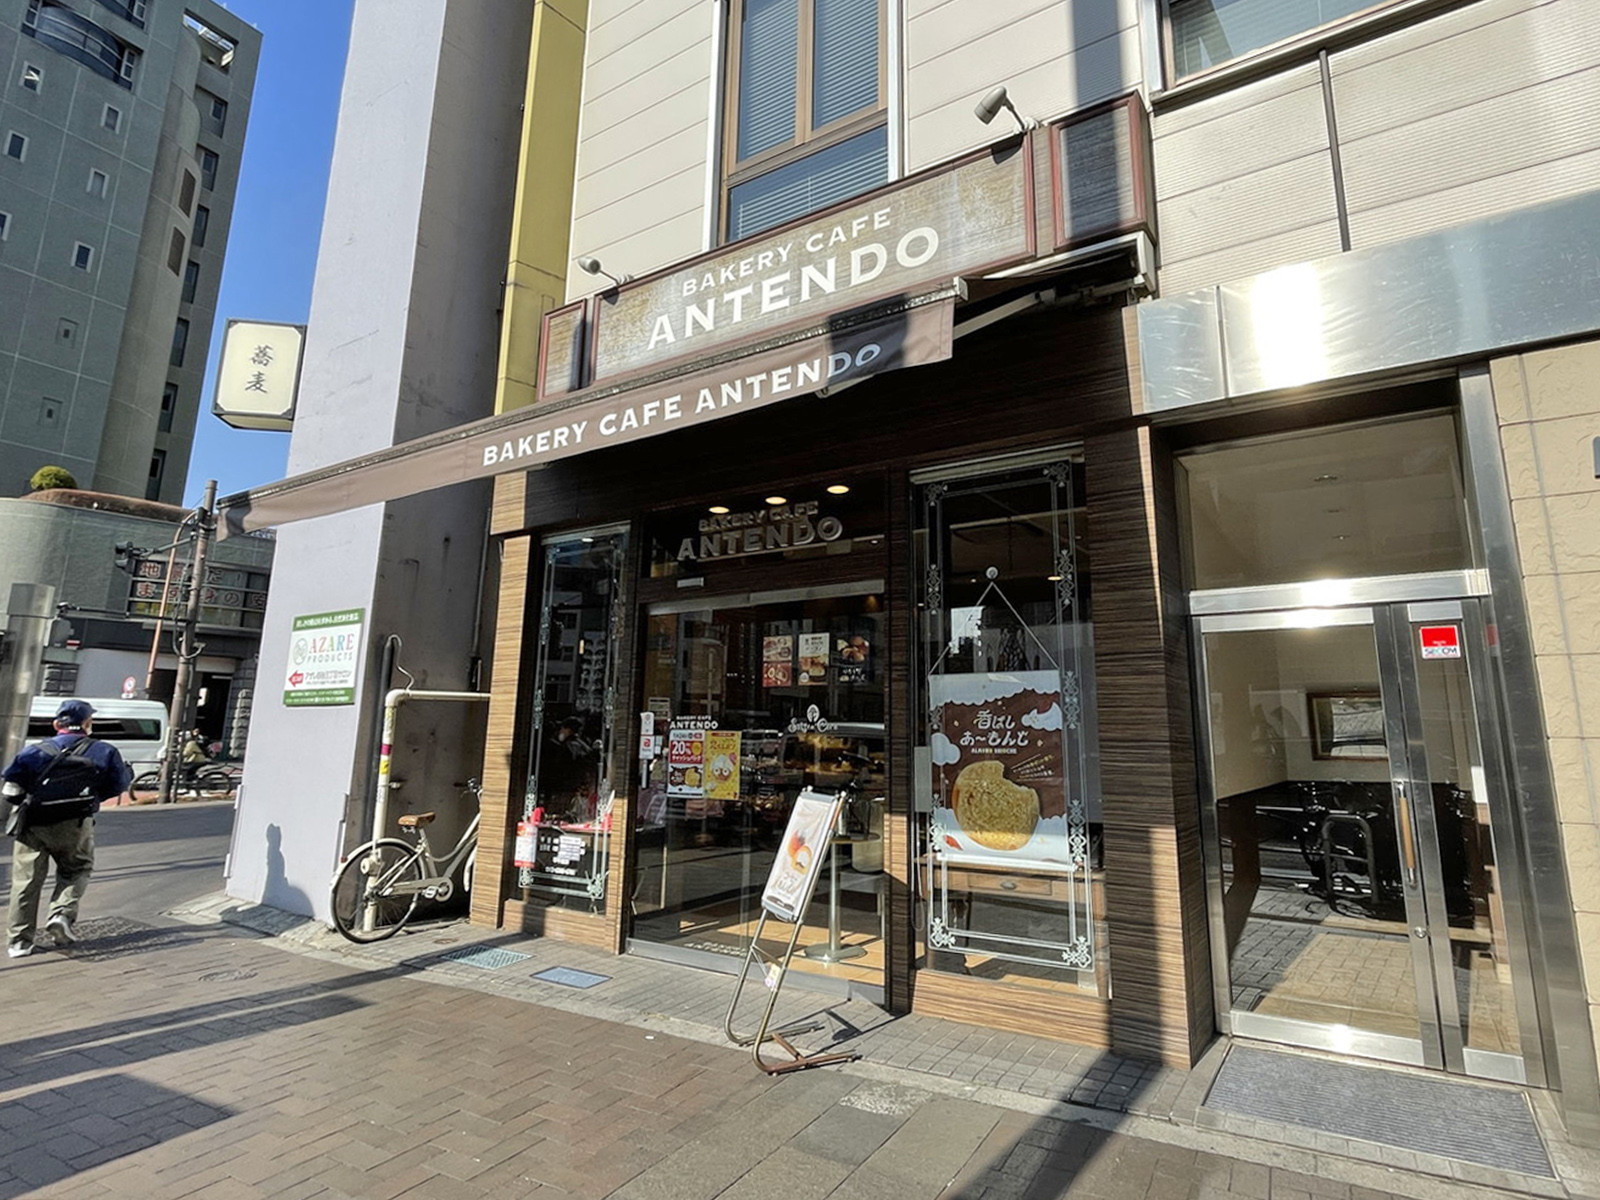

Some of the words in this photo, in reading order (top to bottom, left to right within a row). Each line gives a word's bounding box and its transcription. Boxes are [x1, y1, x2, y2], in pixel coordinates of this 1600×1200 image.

[682, 243, 794, 297] BAKERY
[806, 207, 891, 252] CAFE
[647, 226, 940, 350] ANTENDO
[245, 345, 274, 394] 蕎麦
[483, 421, 587, 466] BAKERY
[599, 395, 681, 435] CAFE
[695, 343, 881, 414] ANTENDO
[677, 516, 843, 560] ANTENDO
[699, 510, 765, 531] BAKERY
[769, 501, 819, 521] CAFE
[308, 633, 355, 653] AZARE
[669, 720, 719, 729] ANTENDO
[973, 709, 1015, 730] 香ばし
